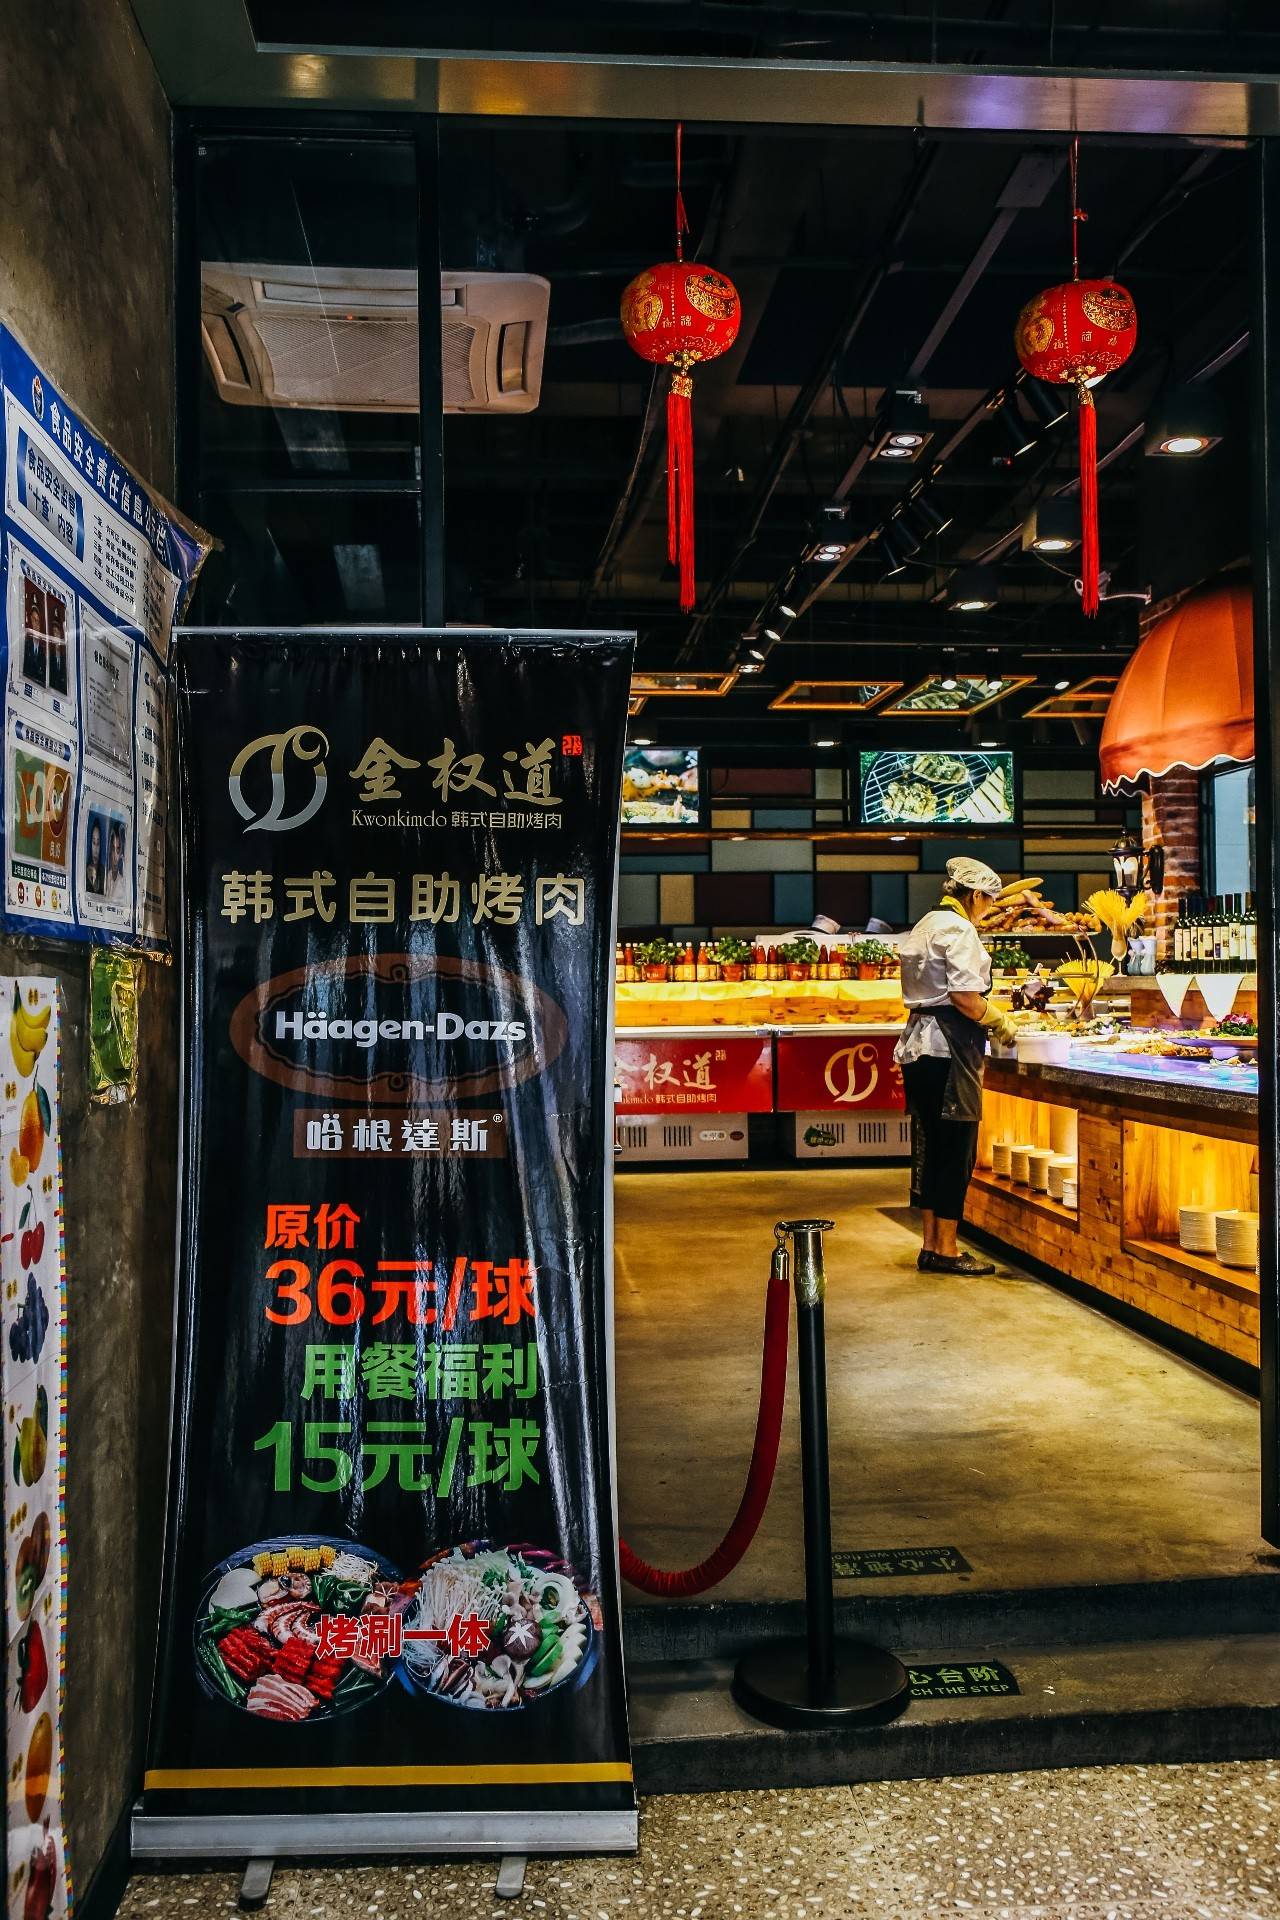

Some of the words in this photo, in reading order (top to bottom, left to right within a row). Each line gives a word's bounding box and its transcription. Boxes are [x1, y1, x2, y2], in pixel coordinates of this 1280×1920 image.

[28, 447, 76, 518] 食品安全监管
[349, 737, 564, 805] 金权道
[451, 811, 563, 829] 韩式自助烤肉
[220, 870, 585, 926] 韩式自助烤肉
[275, 1010, 526, 1048] Häagen-Dazs
[656, 1093, 717, 1104] 韩式自助烤肉
[264, 1203, 360, 1249] 原价
[264, 1257, 537, 1331] 36元/球
[300, 1341, 538, 1400] 用餐福利
[254, 1417, 541, 1498] 15元/球
[315, 1612, 491, 1660] 烤涮一体
[908, 1665, 1000, 1684] 心台阶
[935, 1686, 967, 1696] THE
[970, 1684, 1010, 1694] STEP
